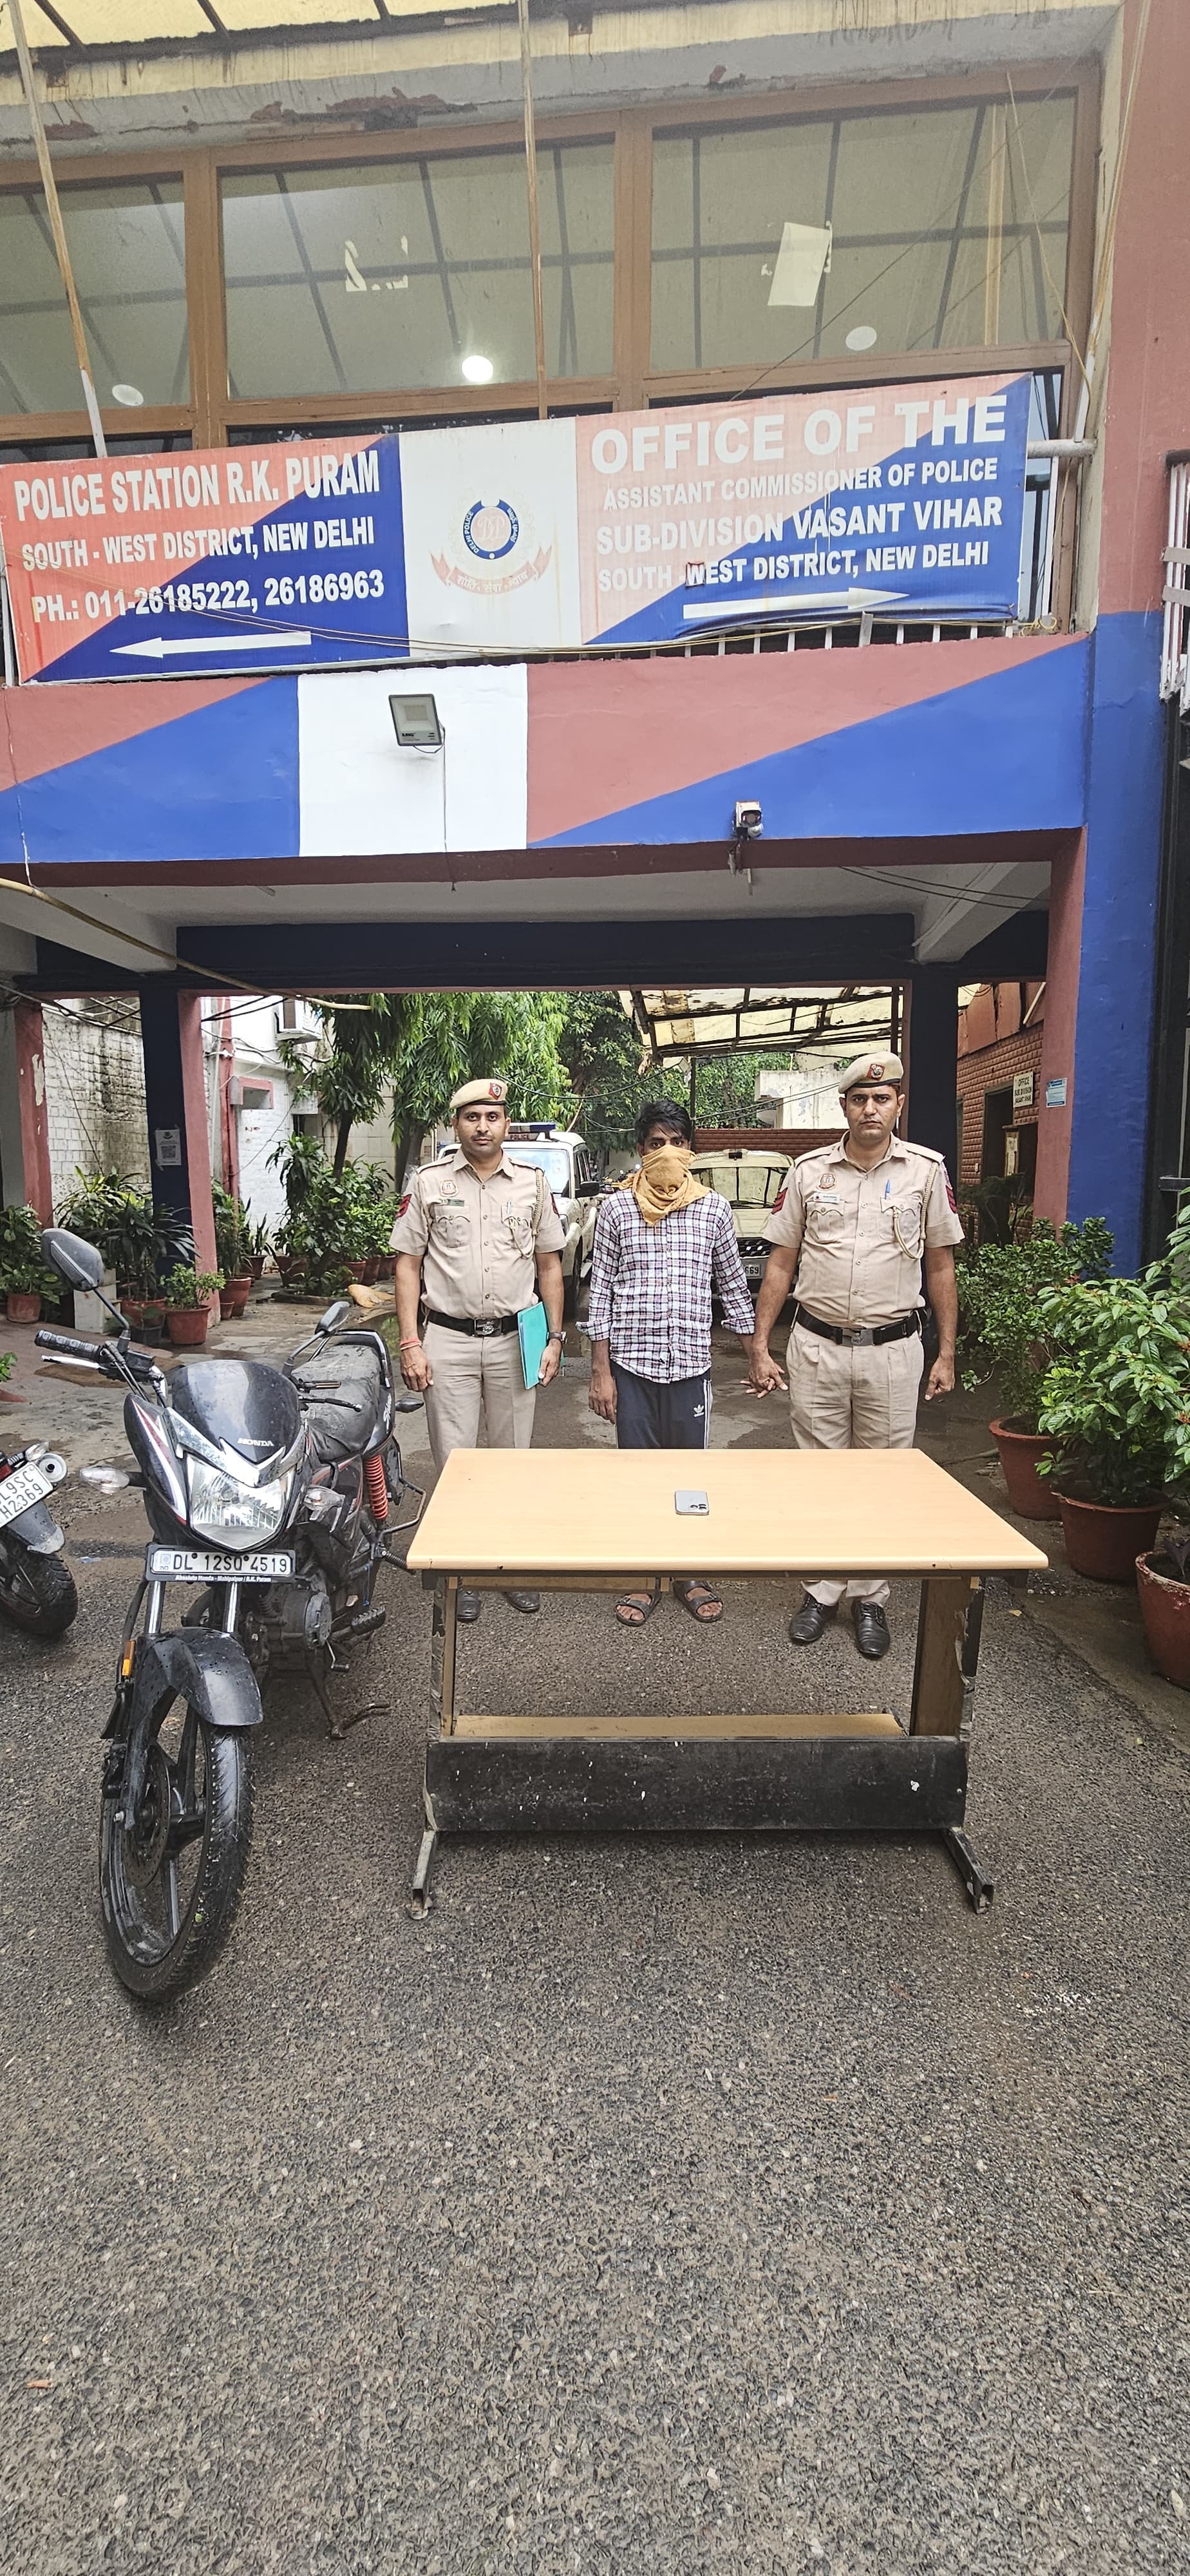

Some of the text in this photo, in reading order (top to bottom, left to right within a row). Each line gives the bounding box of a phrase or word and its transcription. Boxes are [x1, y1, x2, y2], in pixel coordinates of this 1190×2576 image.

[591, 395, 1007, 474] OFFICE OF THE
[14, 450, 380, 522] POLICE STATION R.K. PURAM
[603, 457, 998, 511] ASSISTANT COMMISSIONER OF POLICE
[21, 539, 89, 572] SOUTH
[102, 533, 157, 564] WEST
[162, 526, 258, 560] DISTRICT,
[263, 522, 308, 553] NEW
[313, 516, 374, 549] DELHI
[464, 511, 479, 553] DELHI POLICE
[597, 496, 1003, 555] SUB-DIVISION VASANT VIHAR
[598, 565, 672, 592] SOUTH
[753, 549, 858, 581] DISTRICT,
[865, 545, 916, 572] NEW
[922, 541, 989, 568] DELHI
[32, 569, 384, 623] PH.: 011-26185222, 26186963
[237, 1437, 274, 1446] HONDA
[173, 1554, 193, 1570] DL
[250, 1556, 288, 1573] 4519
